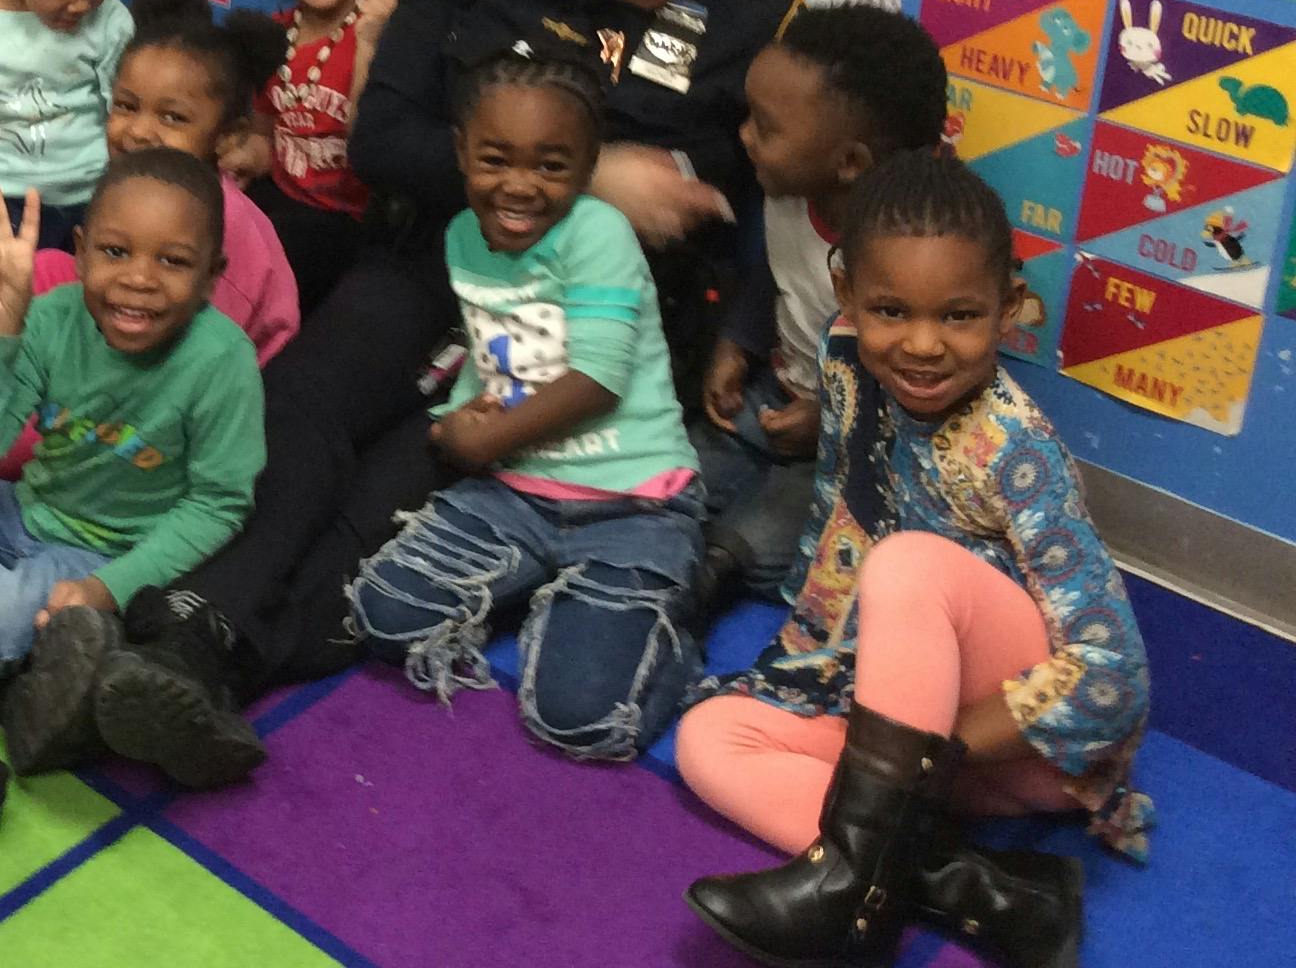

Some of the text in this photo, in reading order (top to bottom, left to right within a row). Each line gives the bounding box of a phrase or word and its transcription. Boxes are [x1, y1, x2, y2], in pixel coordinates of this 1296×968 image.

[1181, 11, 1257, 56] QUICK
[960, 45, 1032, 85] HEAVY
[1186, 108, 1256, 150] SLOW
[1092, 149, 1139, 185] HOT
[1020, 199, 1063, 235] FAR
[1136, 232, 1198, 273] COLD
[1104, 276, 1157, 315] FEW
[1112, 363, 1185, 409] MANY
